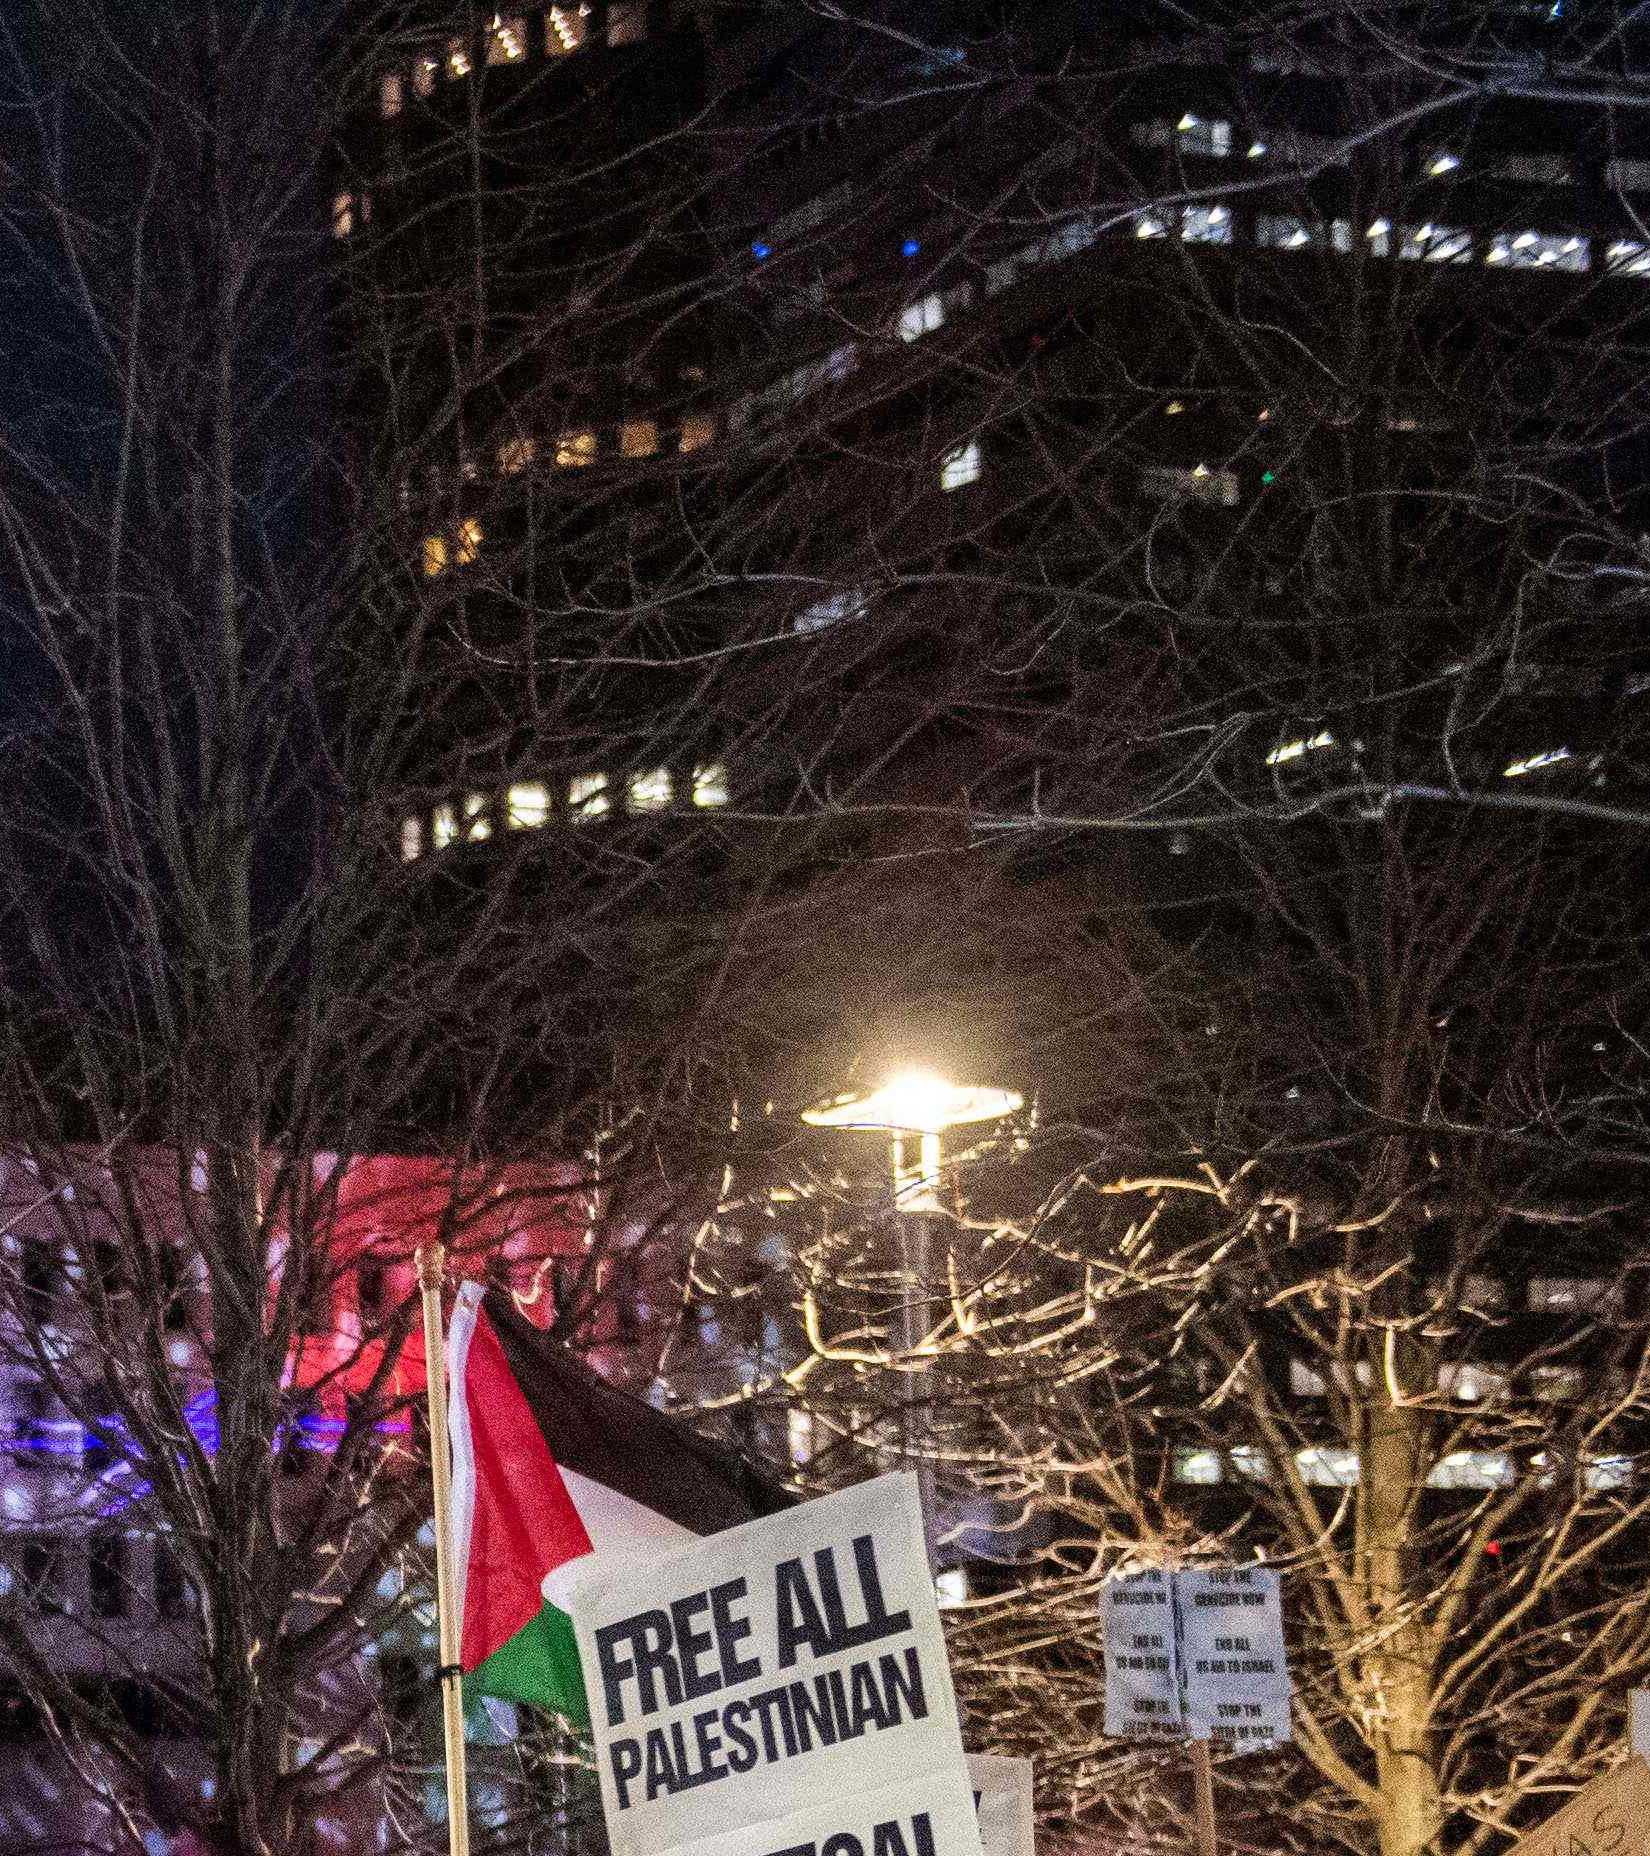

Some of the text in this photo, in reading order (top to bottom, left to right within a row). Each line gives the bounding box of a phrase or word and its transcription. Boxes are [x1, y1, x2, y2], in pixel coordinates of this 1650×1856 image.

[595, 1534, 911, 1727] FREE ALL
[610, 1647, 930, 1810] PALESTINIAN
